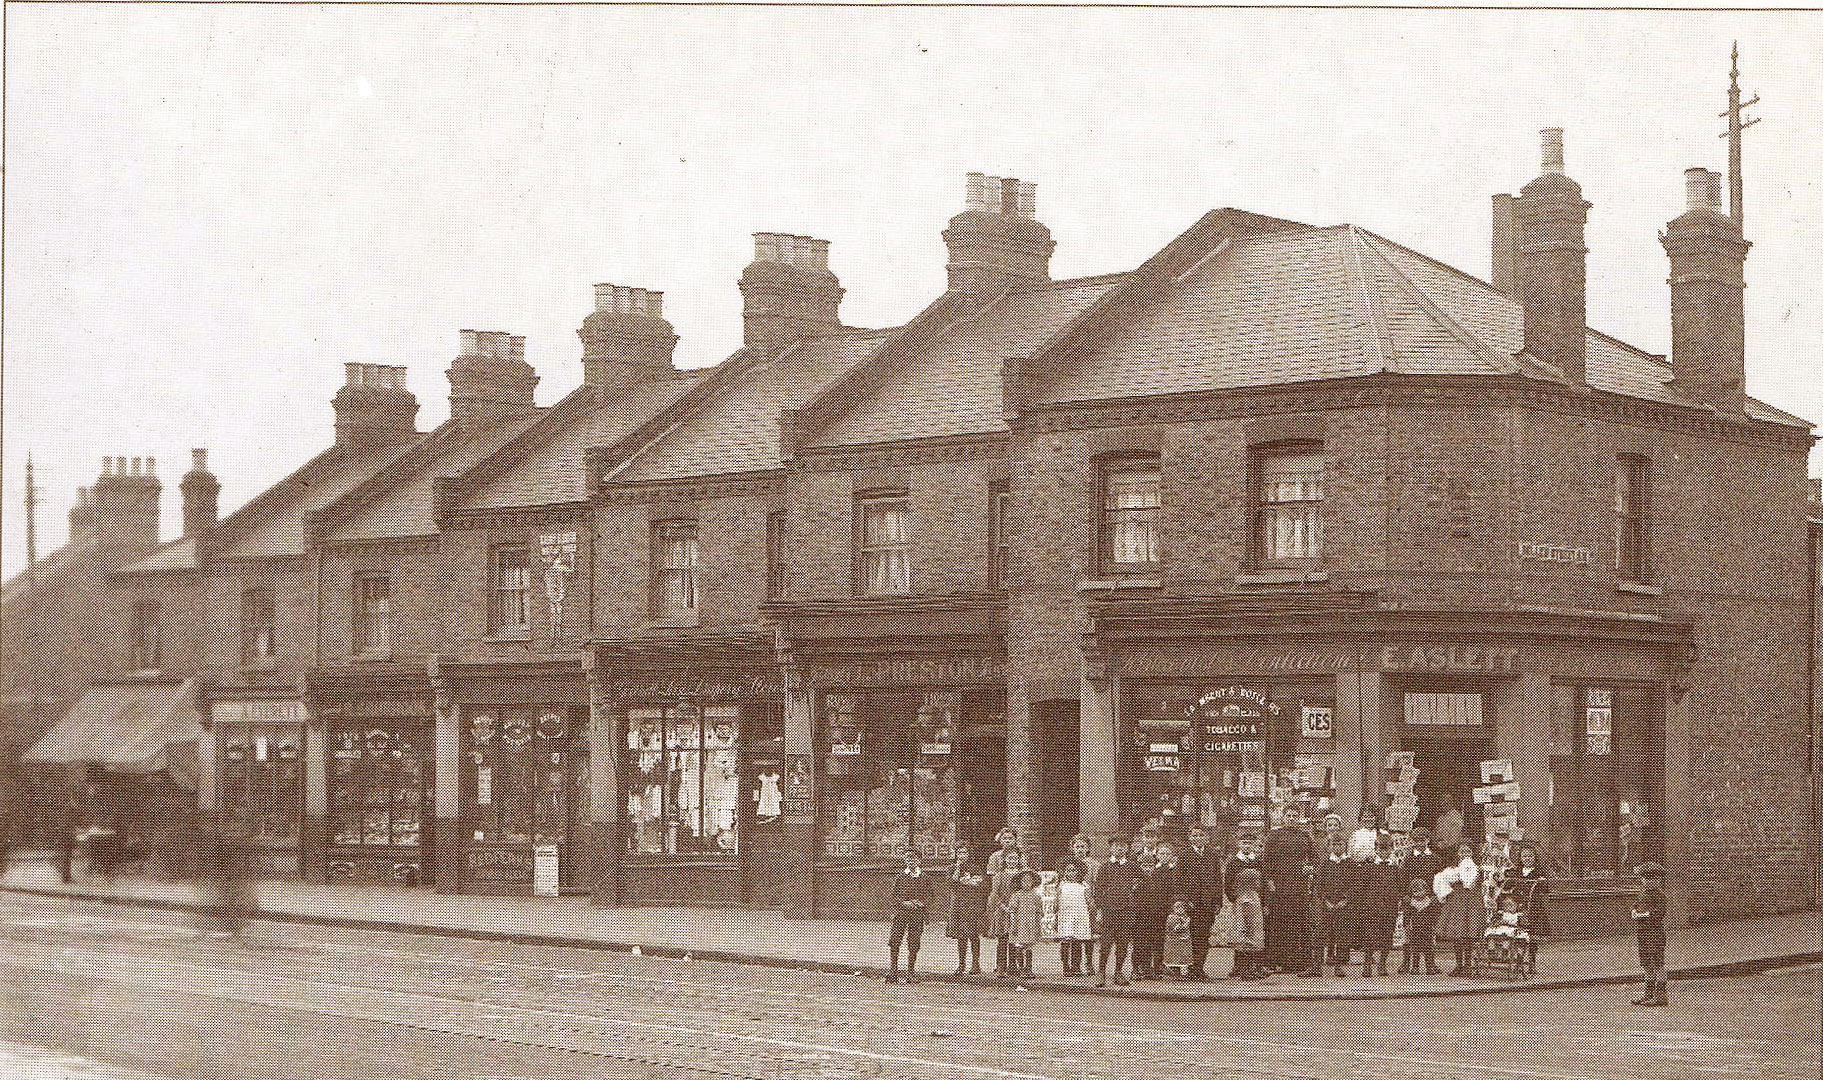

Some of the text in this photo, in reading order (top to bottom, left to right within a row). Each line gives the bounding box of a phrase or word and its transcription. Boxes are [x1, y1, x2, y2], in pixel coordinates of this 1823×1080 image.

[1409, 645, 1520, 670] ASLETT
[876, 656, 976, 681] PRESTON
[1206, 724, 1248, 735] TOBACCO
[1204, 741, 1260, 752] CIGARETTES
